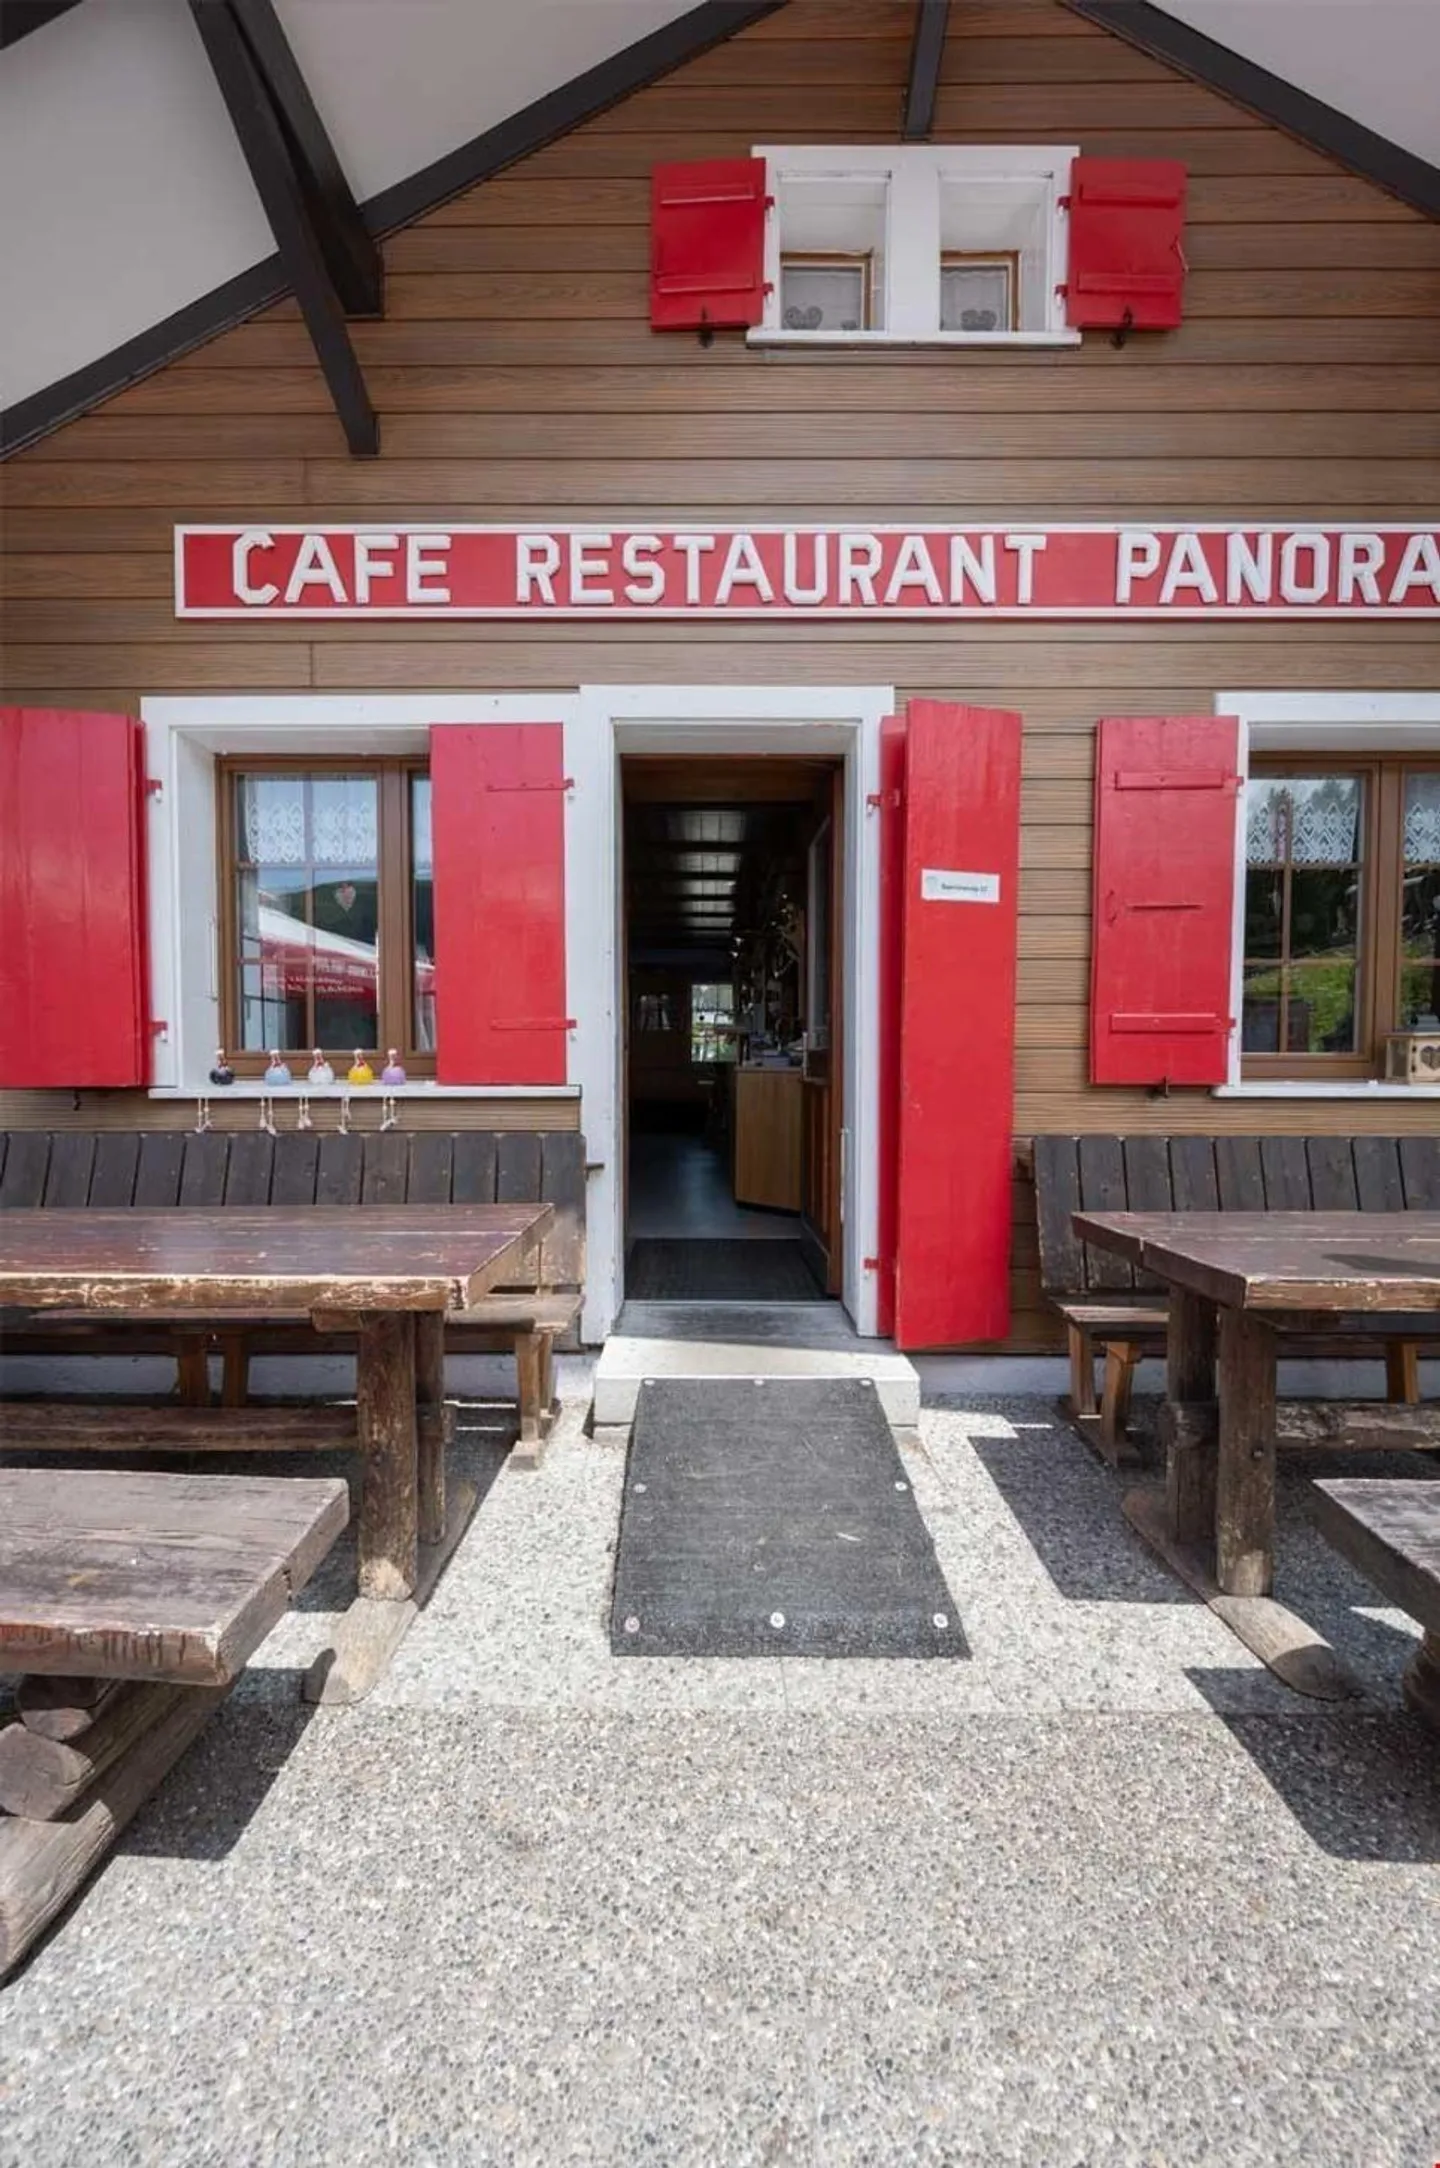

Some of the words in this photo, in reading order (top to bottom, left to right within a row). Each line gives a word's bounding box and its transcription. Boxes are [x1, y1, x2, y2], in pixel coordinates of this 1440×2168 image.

[232, 531, 452, 606] CAFE
[516, 533, 1047, 606] RESTAURANT
[1116, 531, 1440, 606] PANORA
